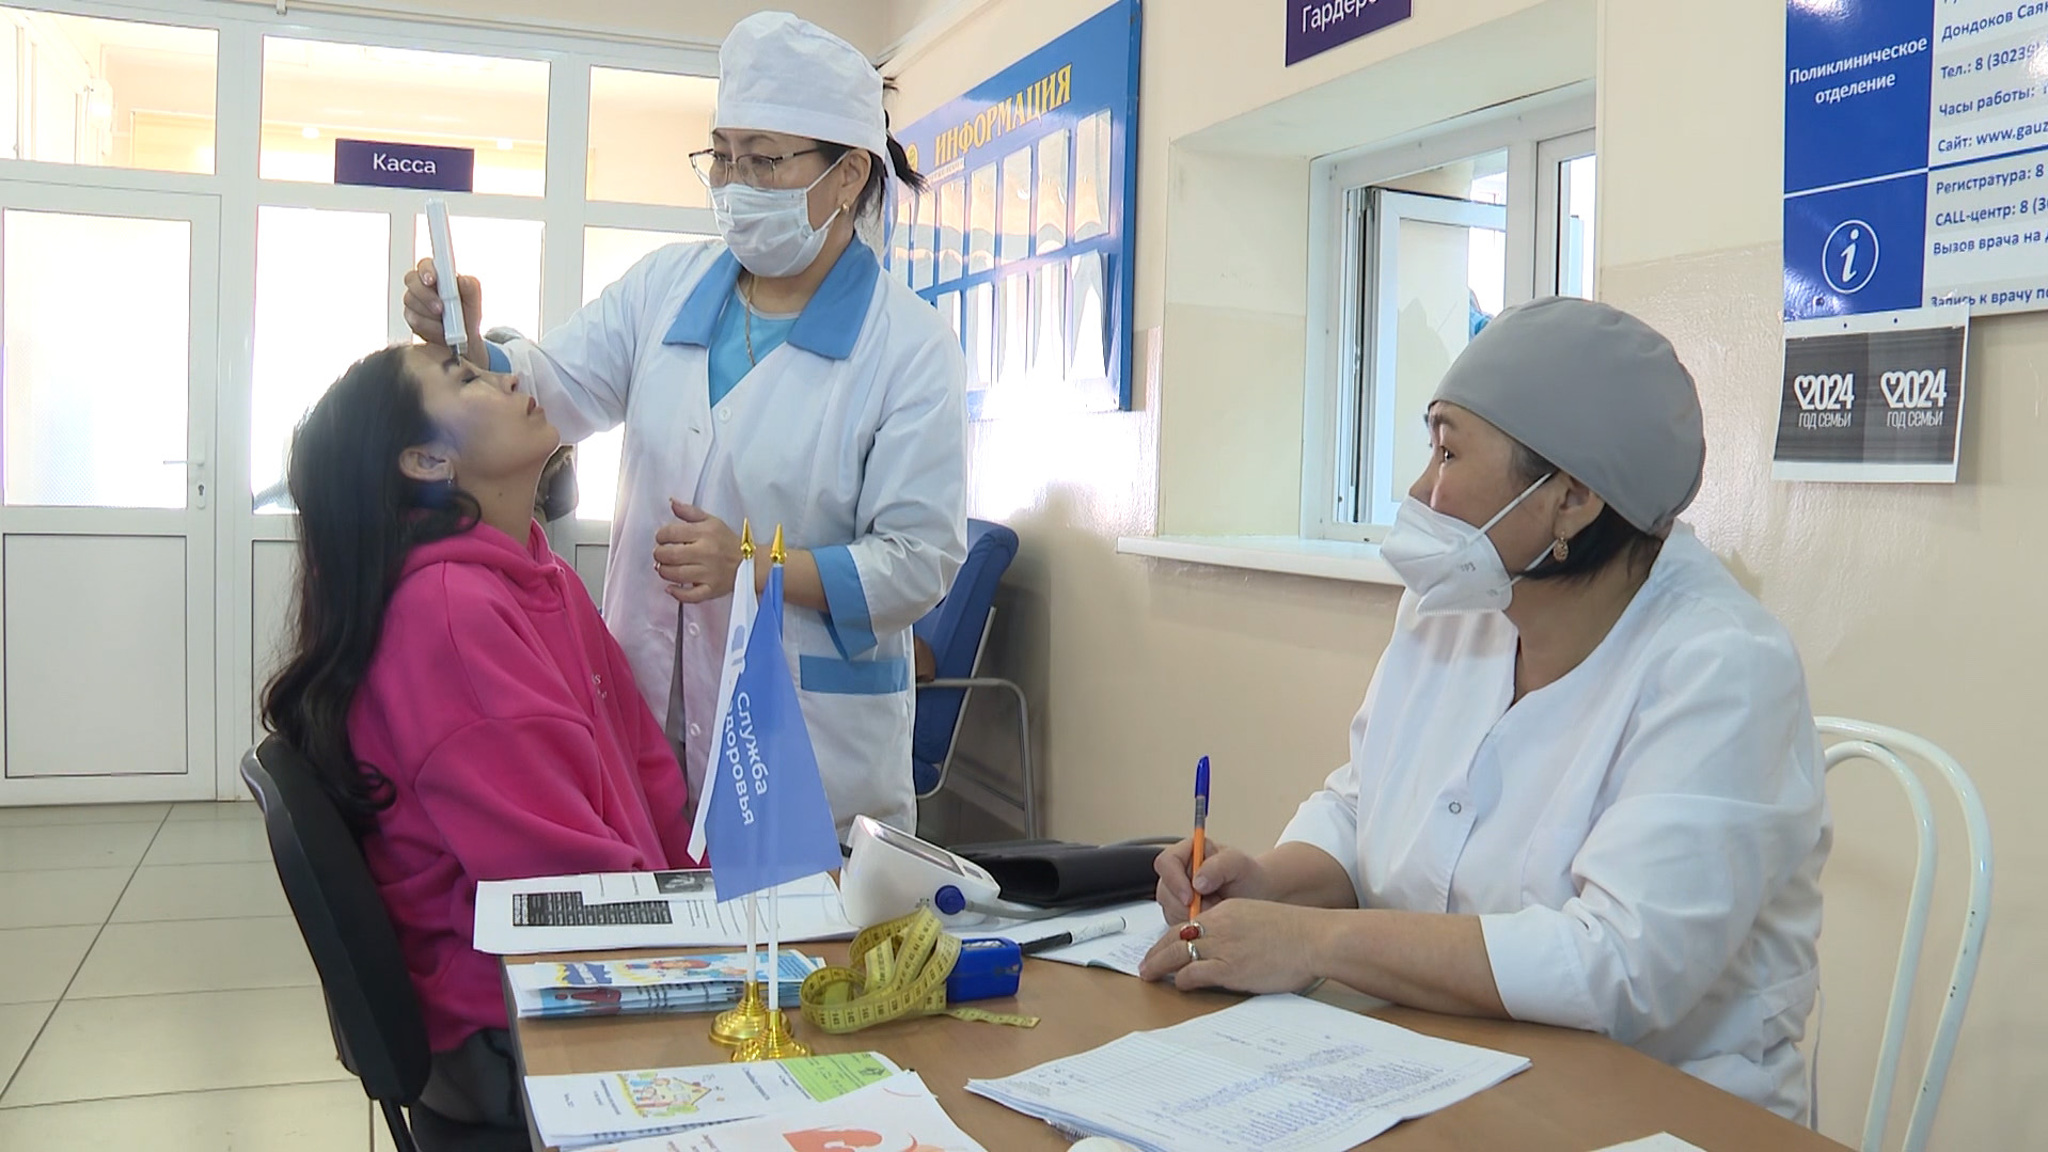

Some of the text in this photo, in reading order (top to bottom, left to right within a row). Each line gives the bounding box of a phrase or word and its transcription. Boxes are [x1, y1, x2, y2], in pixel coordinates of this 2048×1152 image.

[1941, 11, 2013, 43] Дондоков
[1788, 37, 1928, 86] Поликлиническое
[1941, 62, 1972, 79] Тел.:
[1975, 56, 1983, 71] 8
[1814, 72, 1896, 105] отделение
[1939, 100, 1973, 116] Часы
[1977, 86, 2035, 112] работы:
[934, 62, 1072, 168] ИНФОРМАЦИЯ
[1938, 134, 1972, 152] Сайт:
[373, 152, 437, 175] Касса
[1936, 163, 2044, 195] Регистратура: 8
[1935, 196, 2048, 227] CALL-центр: 8 (3
[1933, 238, 1975, 256] Вызов
[1979, 233, 2019, 252] врача
[2023, 230, 2041, 244] на
[1979, 293, 1987, 304] к
[1991, 288, 2033, 306] врачу
[1794, 373, 1855, 410] 2024
[1880, 368, 1947, 410] 2024
